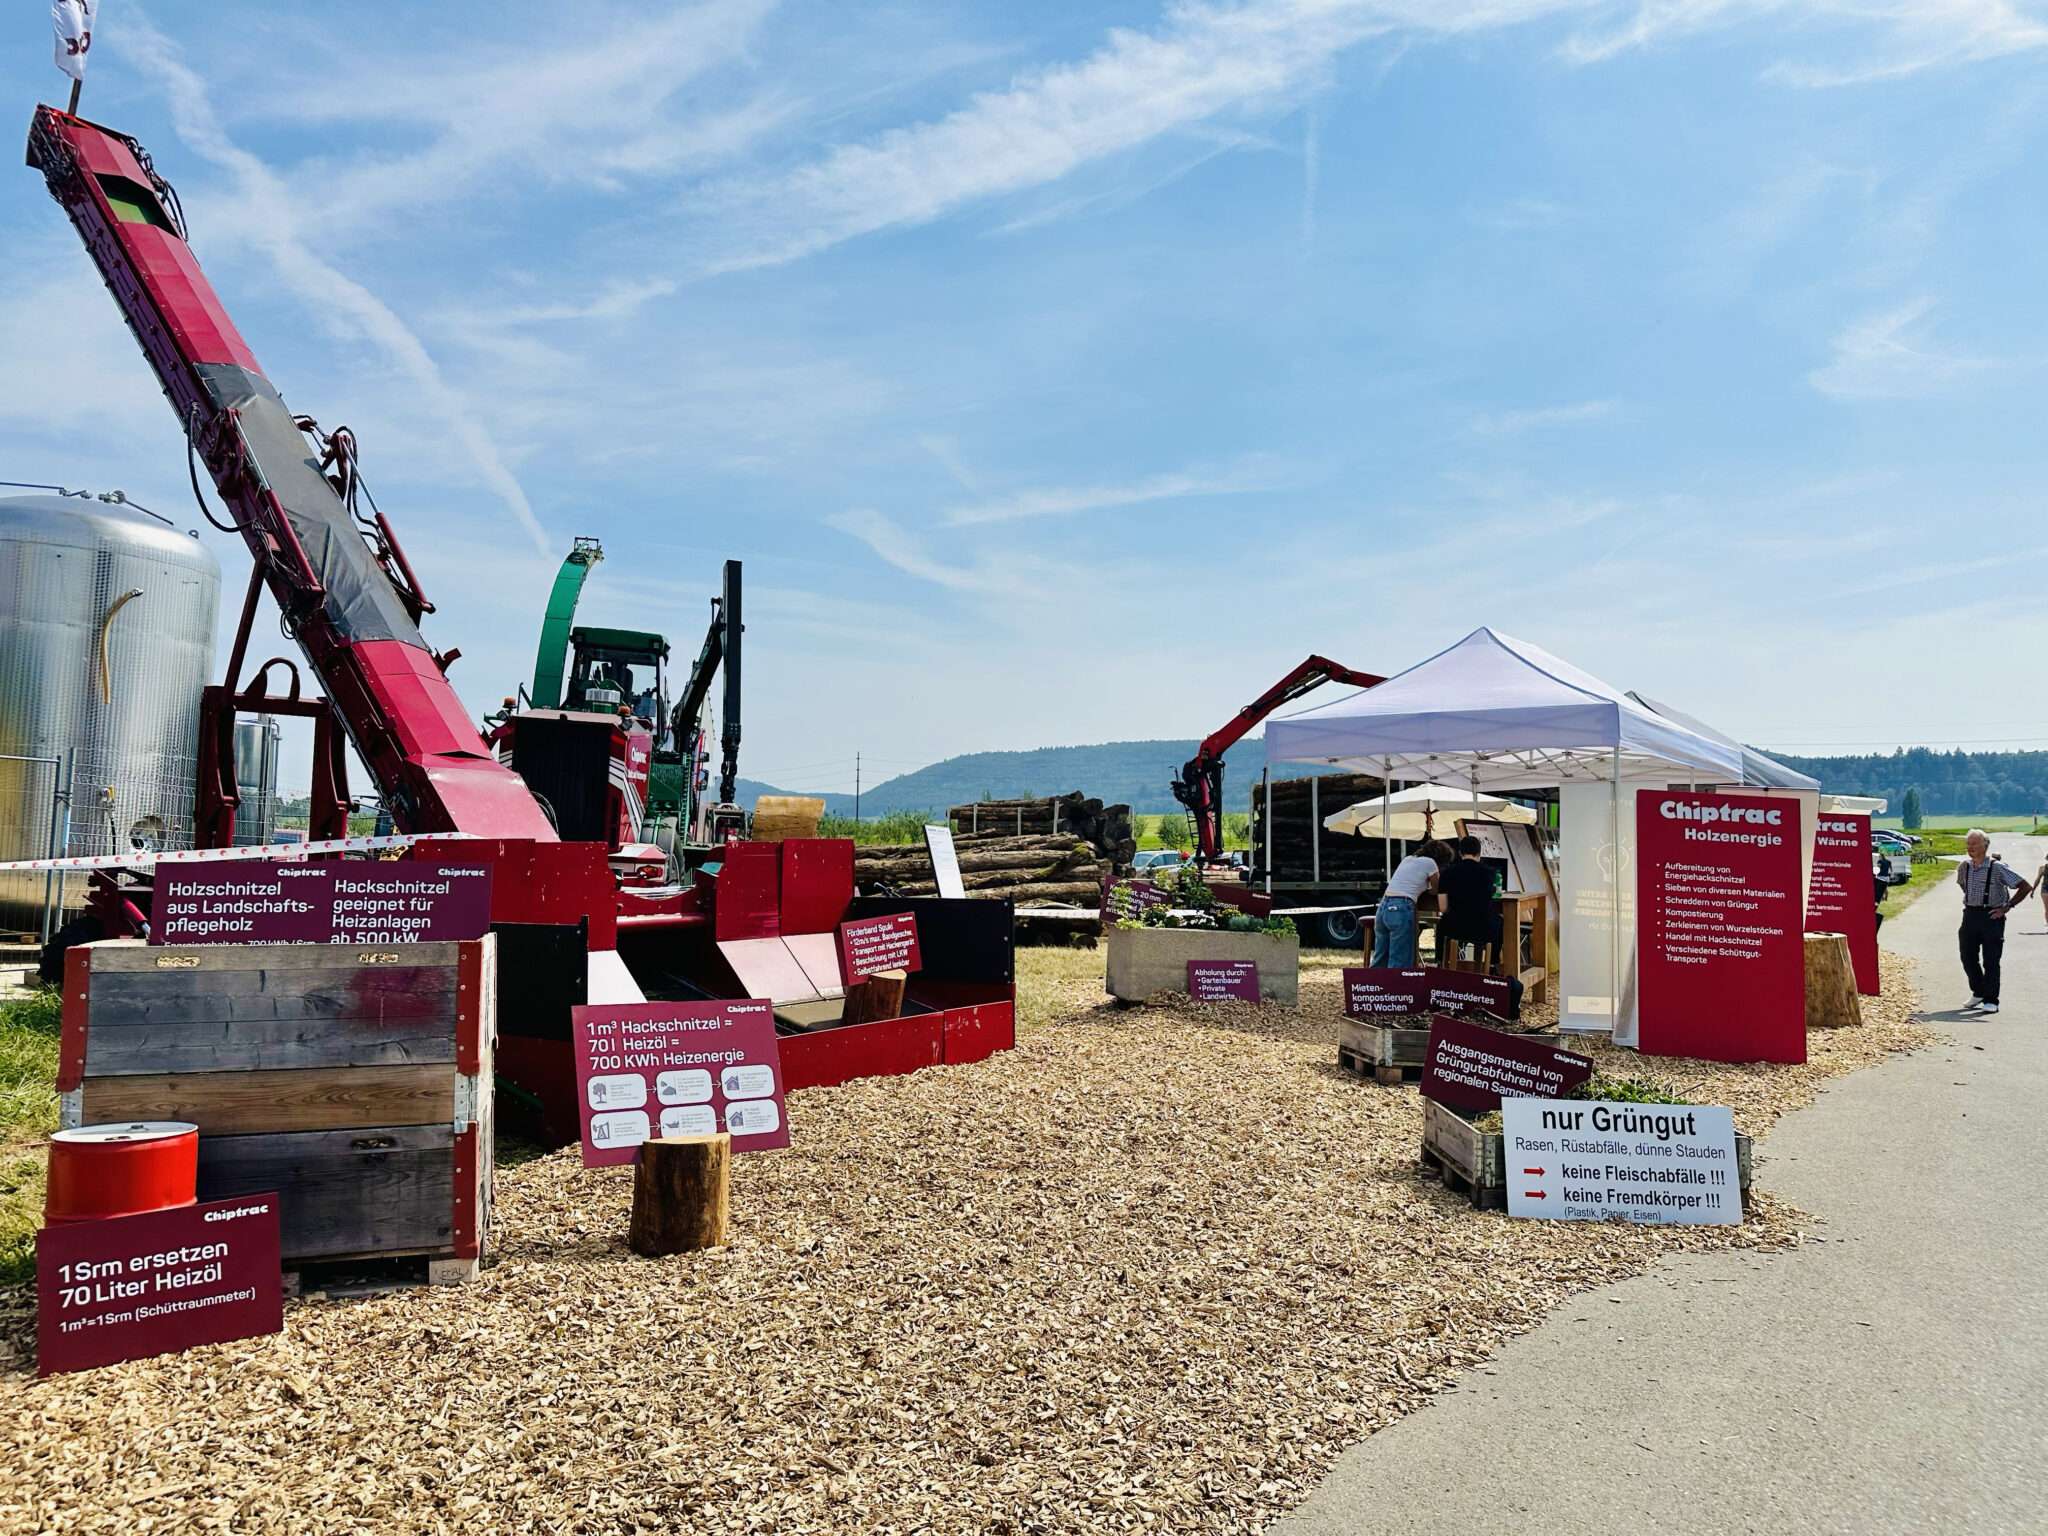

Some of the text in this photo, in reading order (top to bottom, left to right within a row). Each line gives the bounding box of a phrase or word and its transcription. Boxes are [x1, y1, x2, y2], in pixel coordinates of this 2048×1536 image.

[1660, 800, 1782, 825] Chiptrac
[1685, 828, 1782, 847] Holzenergie
[1817, 837, 1859, 847] Wärme
[277, 868, 326, 878] Chiptrac
[438, 868, 485, 877] Chiptrac
[1665, 863, 1715, 874] Aufbereitung
[1665, 872, 1746, 884] Energiehackschnitzel
[169, 882, 281, 896] Holzschnitzel
[335, 879, 450, 895] Hackschnitzel
[1665, 883, 1691, 892] Sieben
[1708, 887, 1741, 896] diversen
[1743, 889, 1785, 899] Materialien
[167, 899, 315, 914] aus Landschafts-
[333, 897, 433, 914] geeignet für
[1665, 896, 1758, 911] Schreddern von Grüngut
[1665, 908, 1724, 920] Kompostierung
[166, 917, 253, 936] pflegeholz
[332, 913, 431, 932] Heizanlagen
[1665, 920, 1708, 931] Zerkleinern
[1726, 925, 1783, 935] Wurzelstöcken
[1665, 932, 1692, 941] Handel
[1708, 935, 1763, 946] Hackschnitzel
[1666, 945, 1762, 959] Verschiedene Schüttgut-
[1666, 954, 1708, 964] Transporte
[1195, 969, 1225, 978] Abholung
[1351, 984, 1384, 992] Mieten-
[1352, 993, 1414, 1004] kompostierung
[1430, 989, 1495, 1005] geschreddertes
[1353, 1003, 1408, 1012] 8-10 Wochen
[621, 1016, 721, 1034] Hackschnitzel
[623, 1036, 667, 1051] Heizöl
[589, 1048, 745, 1070] 700 KWh Heizenergie
[1438, 1039, 1564, 1083] Ausgangsmaterial von
[1433, 1067, 1489, 1090] regionalen
[1436, 1052, 1558, 1095] Grüngutabfuhren und
[1542, 1107, 1696, 1140] nur Grüngut
[1516, 1137, 1725, 1159] Rasen, Rüstabfälle, dünne Stauden
[1562, 1164, 1725, 1185] keine Fleischabfälle !!!
[1563, 1187, 1721, 1210] keine Fremdkörper !!!
[204, 1204, 269, 1223] Chiptrac
[1564, 1206, 1599, 1219] (Plastik,
[1633, 1210, 1661, 1221] Eisen)
[129, 1242, 229, 1272] ersetzen
[58, 1262, 222, 1309] 70 Liter Heizöl
[135, 1287, 256, 1322] (Schüttraummeter)
